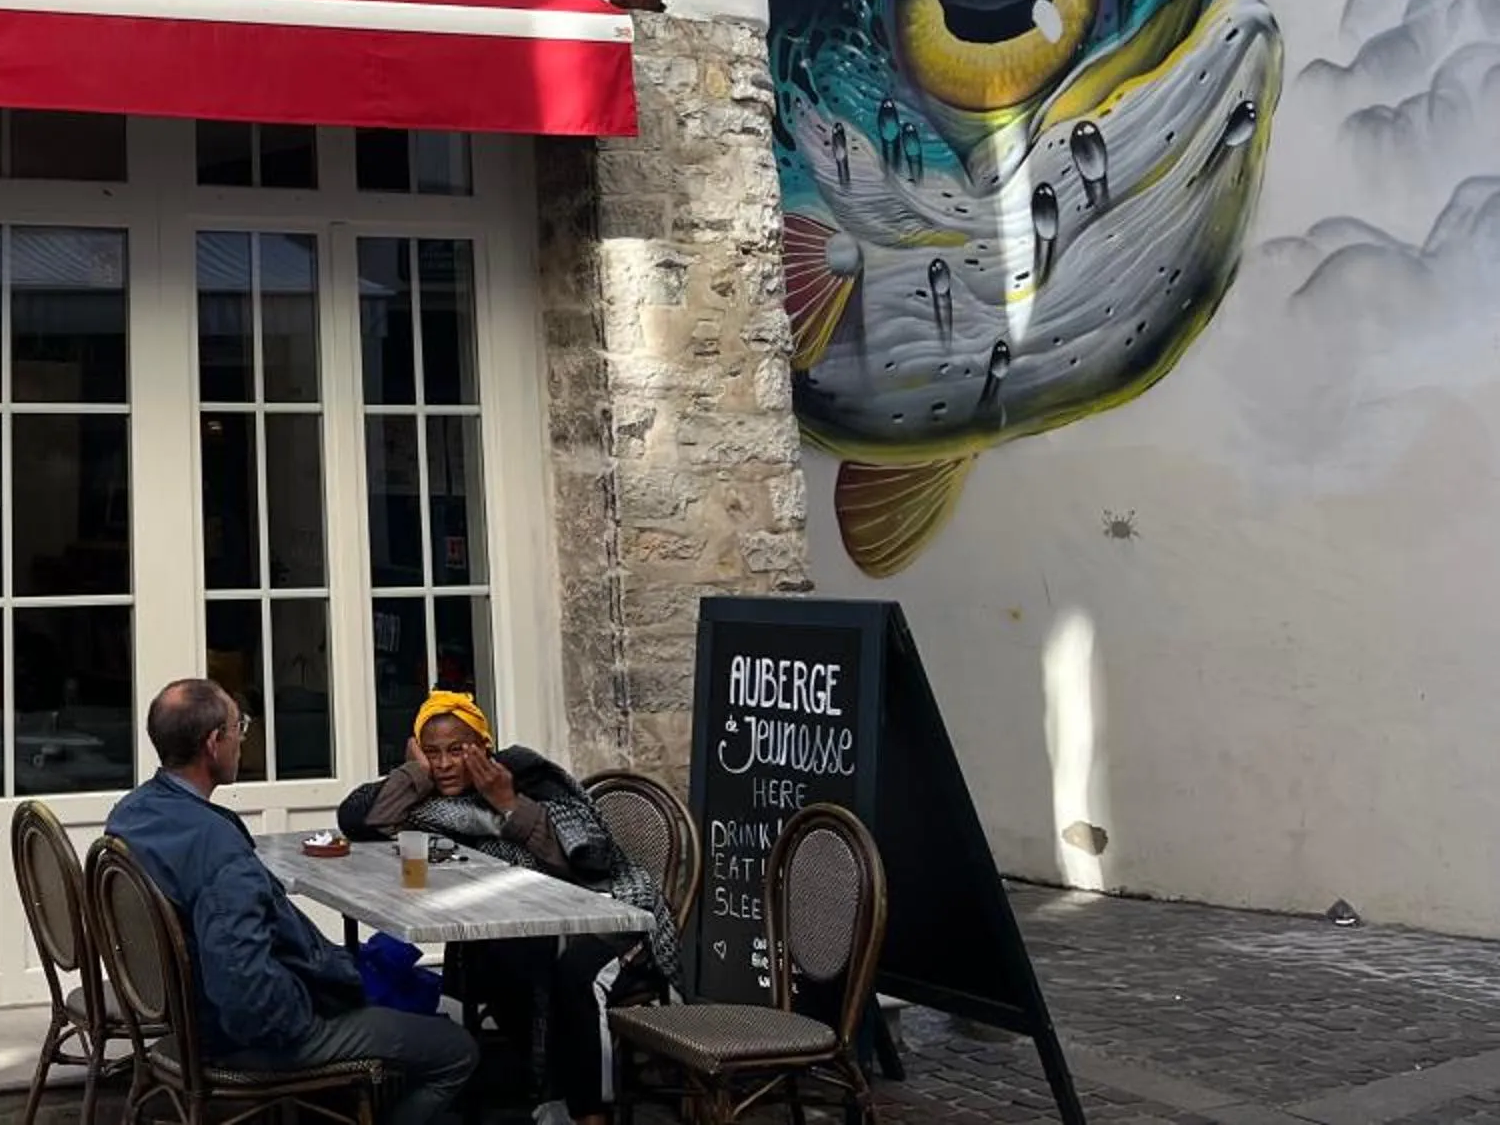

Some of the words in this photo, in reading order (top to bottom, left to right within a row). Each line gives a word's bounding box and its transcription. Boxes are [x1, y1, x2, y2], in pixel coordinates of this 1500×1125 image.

[729, 655, 842, 716] AUBERGE
[718, 716, 855, 776] Jeunesse
[752, 777, 808, 809] HERE
[713, 886, 763, 921] SLEE
